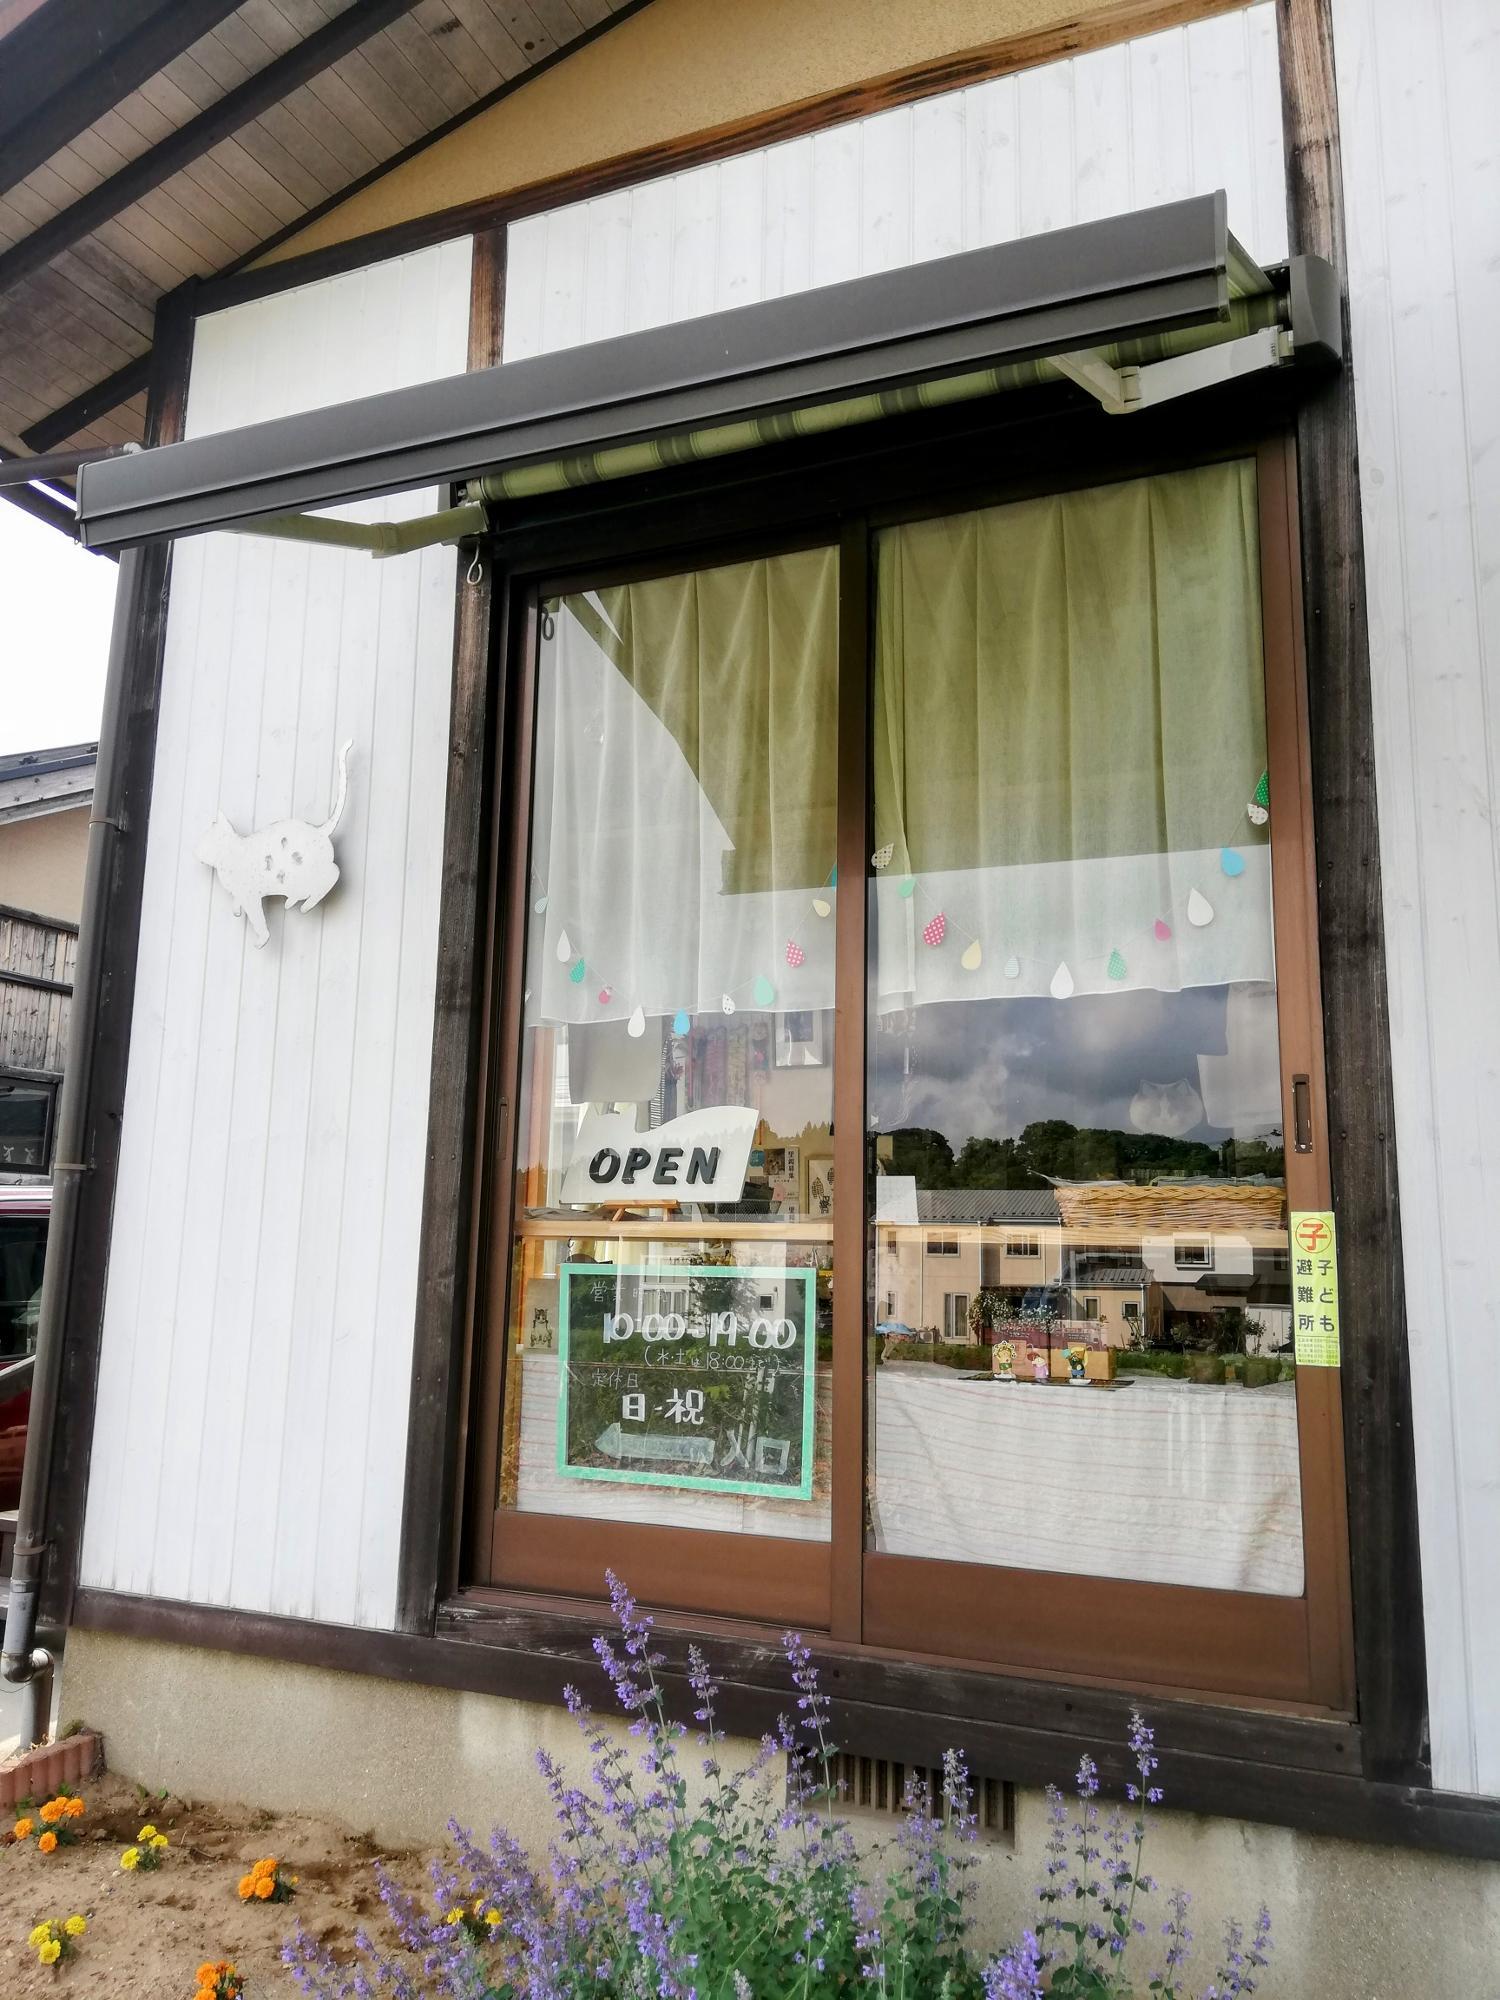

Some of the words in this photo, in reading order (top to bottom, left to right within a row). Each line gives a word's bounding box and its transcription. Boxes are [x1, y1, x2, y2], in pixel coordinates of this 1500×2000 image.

[589, 1147, 721, 1184] OPEN
[1299, 1223, 1328, 1251] 子
[1296, 1259, 1315, 1332] 避難所
[1317, 1259, 1335, 1332] 子ども
[592, 1368, 638, 1389] 定休日
[720, 1429, 791, 1475] 入口
